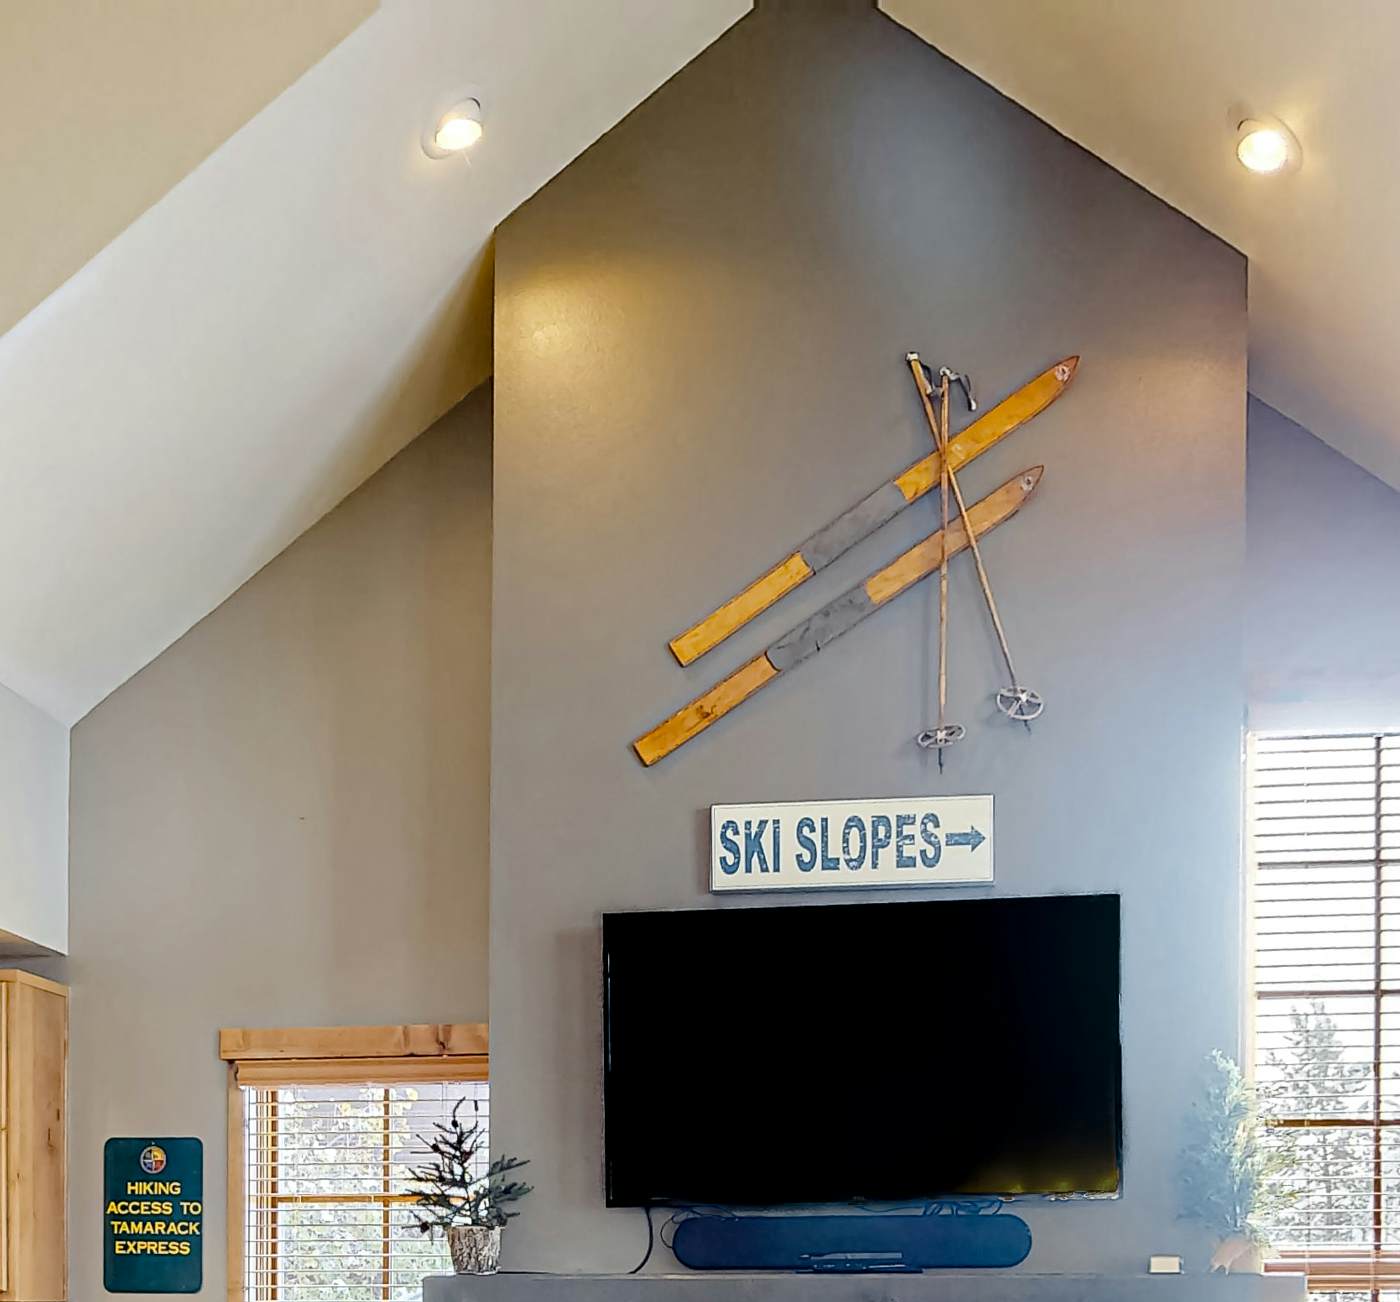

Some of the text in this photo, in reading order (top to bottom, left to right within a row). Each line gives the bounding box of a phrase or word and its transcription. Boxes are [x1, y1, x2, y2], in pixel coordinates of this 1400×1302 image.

[719, 812, 942, 875] SKI SLOPES
[126, 1181, 182, 1195] HIKING
[107, 1201, 202, 1215] ACCESS TO
[111, 1221, 201, 1235] TAMARACK
[115, 1240, 191, 1255] EXPRESS
